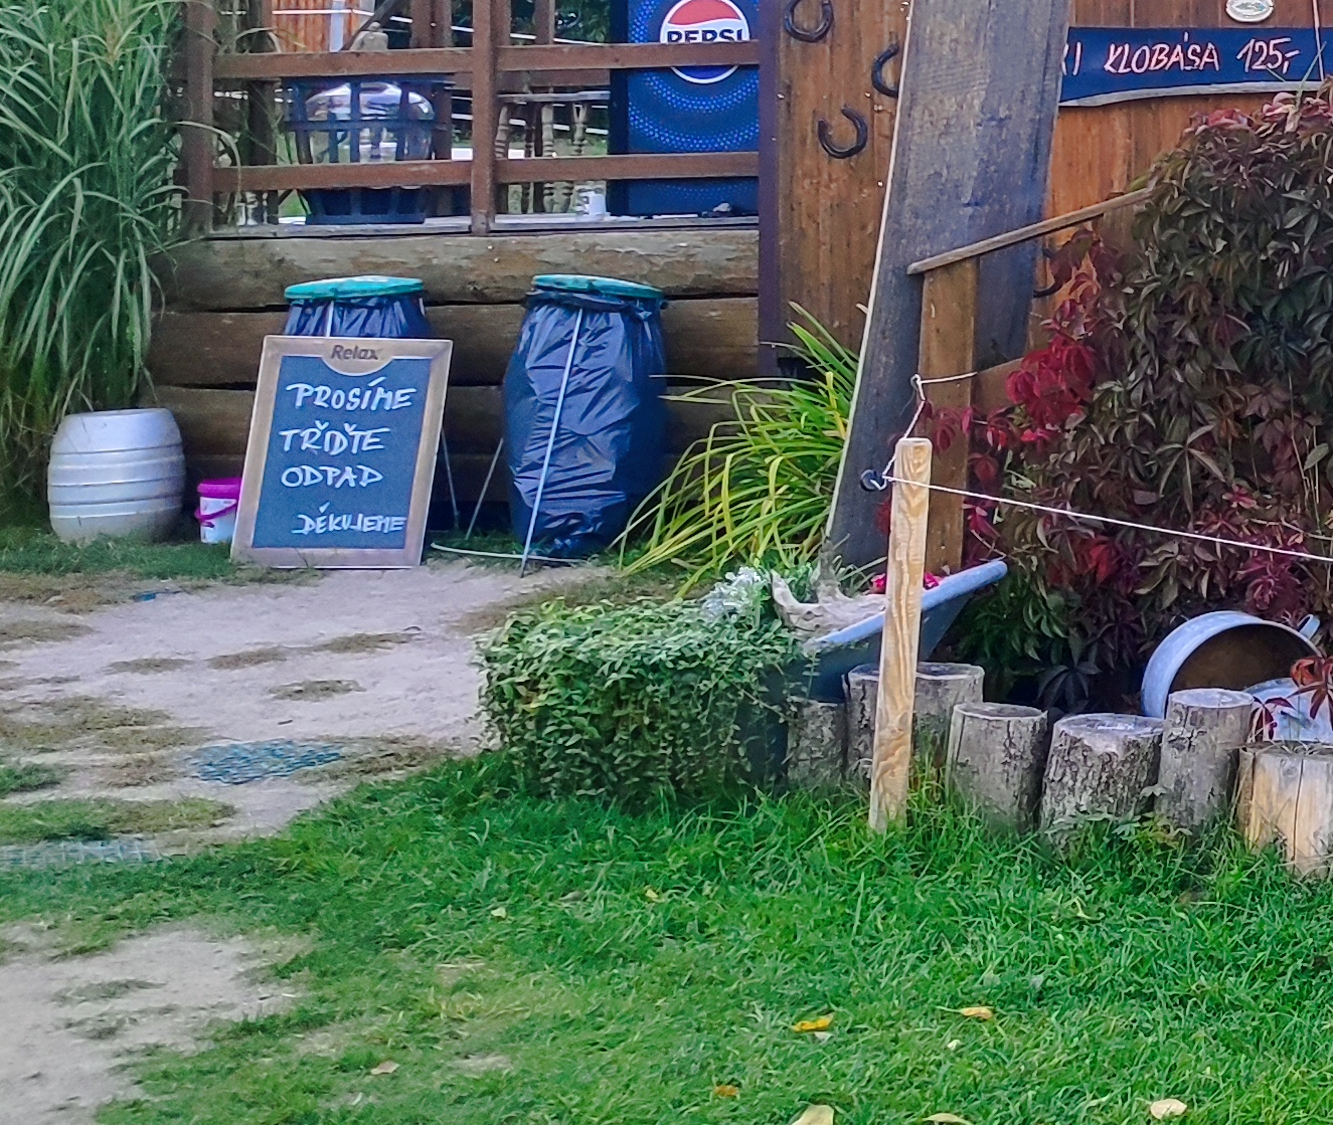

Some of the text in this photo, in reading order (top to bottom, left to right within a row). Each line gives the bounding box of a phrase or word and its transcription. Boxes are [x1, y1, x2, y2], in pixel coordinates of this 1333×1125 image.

[1103, 31, 1220, 74] KLOBÁSA
[331, 345, 380, 361] Relax
[285, 377, 417, 411] PROSÍME
[281, 464, 383, 488] ODPAD
